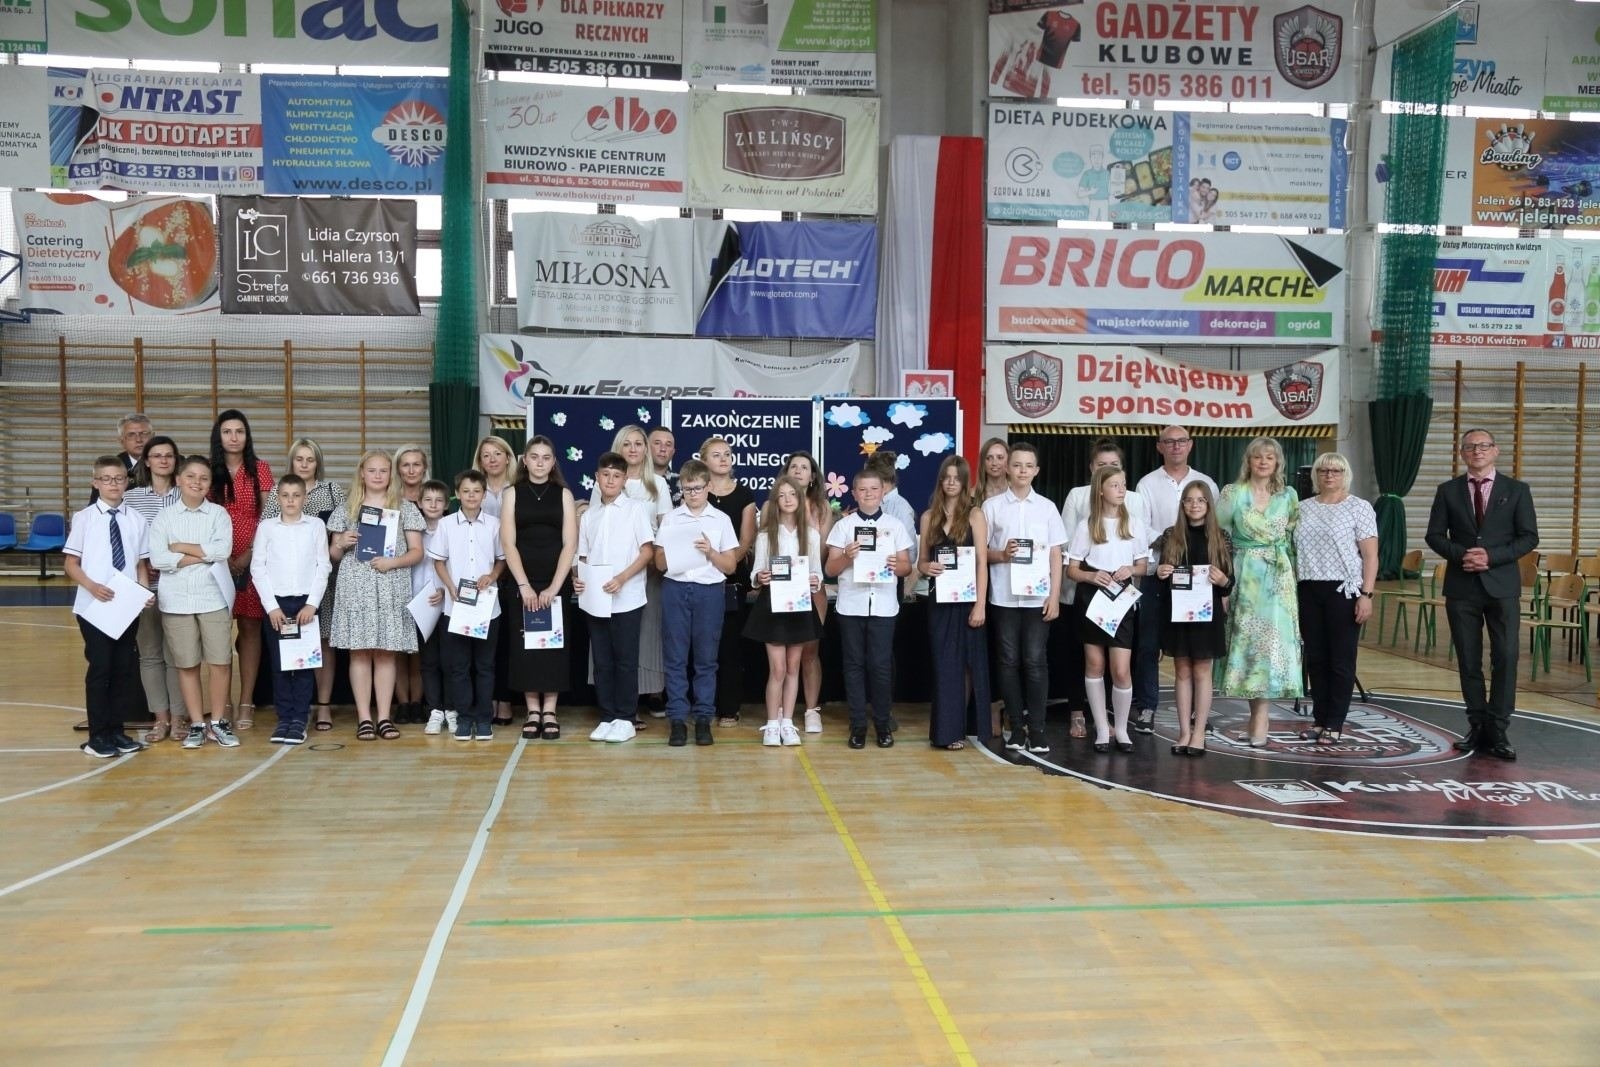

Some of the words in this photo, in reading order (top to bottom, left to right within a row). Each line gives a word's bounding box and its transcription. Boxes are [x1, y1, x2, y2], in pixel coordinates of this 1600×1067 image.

[560, 0, 588, 15] DLA
[593, 0, 665, 19] PIŁKARZY
[494, 19, 543, 36] JUGO
[1096, 0, 1260, 42] GADŻETY
[575, 23, 648, 43] RĘCZNYCH
[488, 44, 523, 52] KWIDZYN
[525, 45, 537, 53] UL.
[539, 47, 581, 55] KOPERNIKA
[1099, 45, 1253, 66] KLUBOWE
[1286, 48, 1330, 67] USAR
[514, 58, 543, 71] tel.
[548, 59, 579, 73] 505
[585, 61, 616, 75] 386
[622, 63, 651, 77] 011
[771, 78, 807, 86] PROGRAMU
[1081, 72, 1118, 97] tel.
[1128, 73, 1171, 98] 505
[1180, 74, 1222, 99] 386
[1231, 75, 1272, 99] 011
[1472, 70, 1523, 96] Miasto
[288, 98, 352, 106] AUTOMATYKA
[286, 110, 355, 119] KLIMATYZACJA
[507, 104, 540, 129] 30
[587, 96, 677, 134] elbo
[995, 109, 1044, 125] DIETA
[1052, 111, 1167, 130] PUDEŁKOWA
[131, 124, 250, 145] FOTOTAPET
[290, 122, 352, 132] WENTYLACJA
[388, 129, 442, 141] DESCO
[285, 135, 358, 144] CHŁODNICTWO
[735, 130, 835, 151] ZIELIŃSCY
[180, 149, 219, 159] technologii
[290, 147, 353, 156] PNEUMATYKA
[504, 145, 596, 160] KWIDZYŃSKIE
[601, 150, 666, 163] CENTRUM
[1481, 148, 1541, 168] Bowling
[73, 163, 99, 178] tel.
[127, 165, 147, 177] 23
[152, 166, 172, 178] 57
[177, 167, 197, 179] 83
[273, 160, 333, 168] HYDRAULIKA
[335, 160, 370, 168] SIŁOWA
[504, 160, 567, 172] BIUROWO
[580, 163, 665, 177] PAPIERNICZE
[293, 178, 432, 192] www.desco.pl
[520, 175, 532, 183] ul.
[543, 176, 564, 185] Maja
[578, 178, 609, 187] 82-500
[612, 180, 650, 189] Kwidzyn
[737, 184, 785, 196] Smakiem
[786, 187, 799, 196] od
[535, 189, 635, 202] www.elbokwidzyn.pl
[1477, 195, 1504, 206] Jeleń
[1509, 197, 1521, 206] 66
[1524, 197, 1535, 208] D,
[1538, 198, 1574, 208] 83-123
[26, 235, 83, 249] Catering
[308, 228, 340, 242] Lidia
[346, 229, 399, 245] Czyrson
[27, 247, 101, 261] Dietetyczny
[1442, 242, 1459, 251] Usług
[1461, 242, 1514, 252] Motoryzacyjnych
[1515, 243, 1541, 252] Kwidzyn
[302, 250, 317, 262] ul.
[323, 250, 371, 263] Hallera
[378, 250, 405, 265] 13/1
[1000, 235, 1206, 290] BRICO
[312, 271, 336, 284] 661
[342, 271, 368, 284] 736
[373, 272, 399, 285] 936
[535, 259, 670, 289] MIŁOSNA
[236, 273, 288, 294] Strefa
[1203, 274, 1315, 298] MARCHE
[237, 295, 264, 303] GABINET
[266, 295, 289, 303] URODY
[531, 290, 591, 301] RESTAURACJA
[750, 290, 818, 300] www.glotech.com.pl
[1011, 315, 1075, 327] budowanie
[1096, 316, 1190, 331] majsterkowanie
[1210, 317, 1267, 331] dekoracja
[1287, 317, 1321, 331] ogród
[1450, 336, 1483, 345] 82-500
[1487, 336, 1527, 346] Kwidzyn
[1077, 354, 1249, 396] Dziękujemy
[1014, 384, 1054, 401] USAR
[1277, 387, 1315, 404] USAR
[1078, 395, 1254, 420] sponsorom
[681, 409, 800, 429] ZAKOŃCZENIE
[1323, 779, 1577, 794] Kwidzyn
